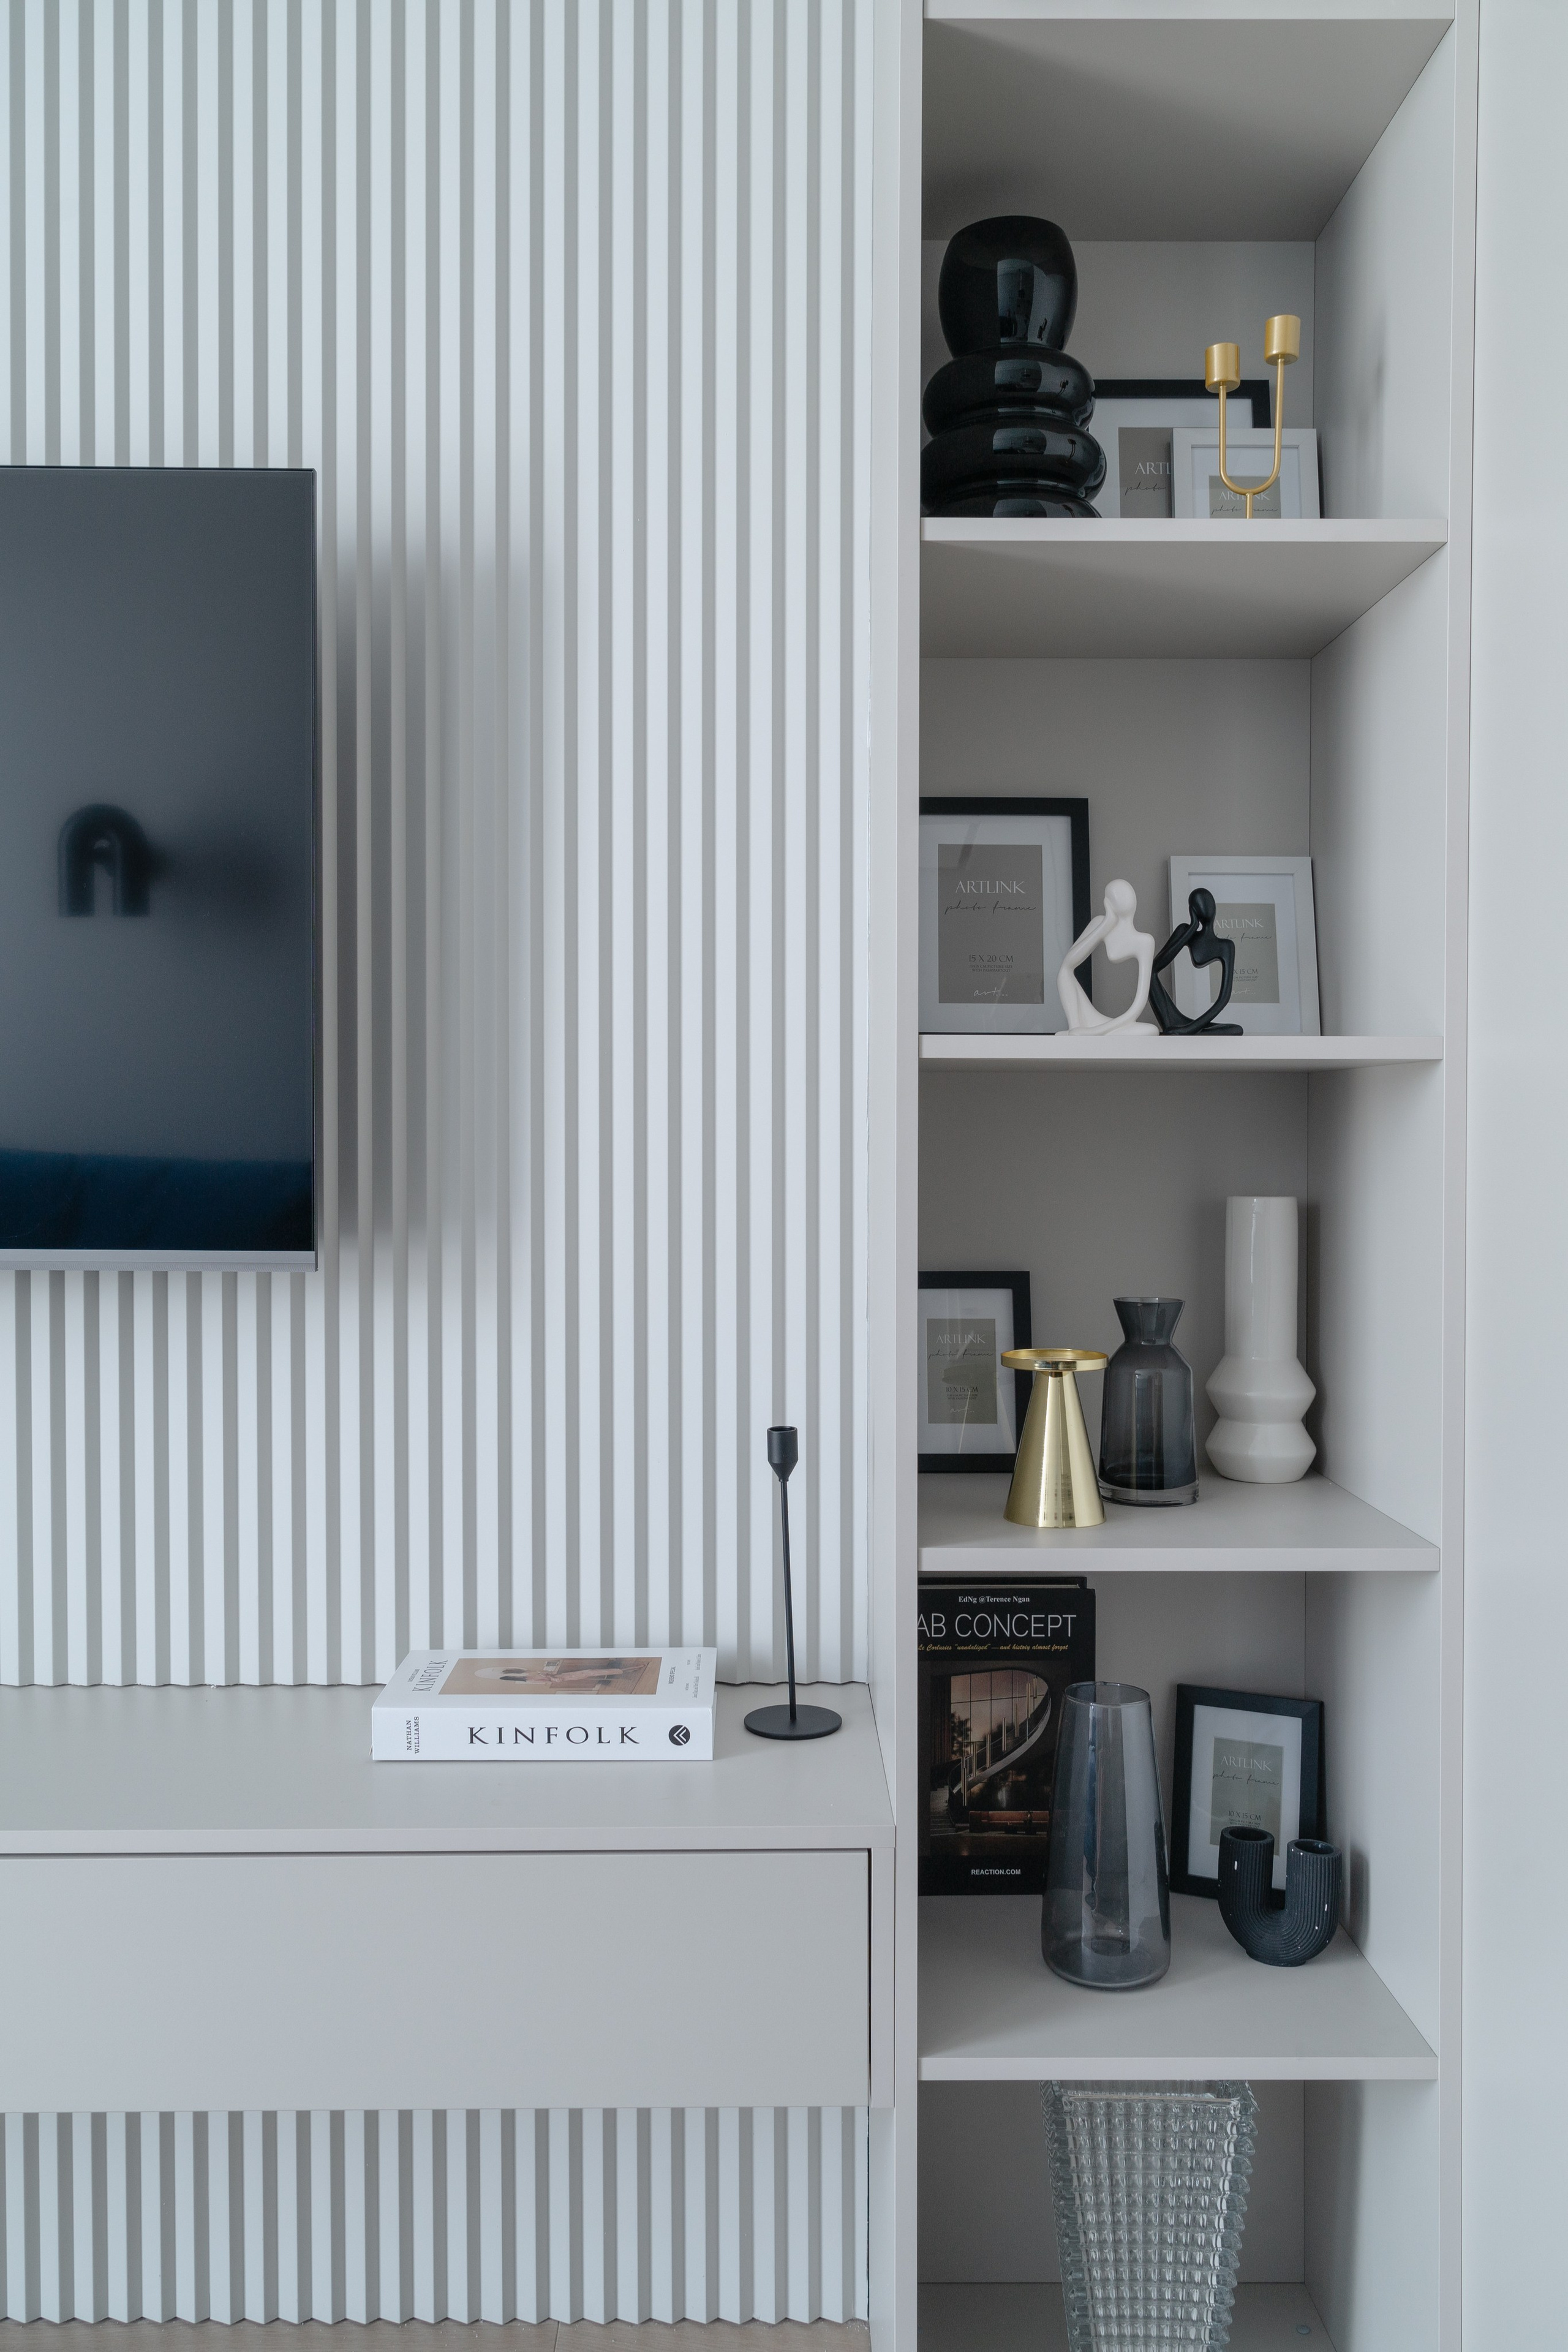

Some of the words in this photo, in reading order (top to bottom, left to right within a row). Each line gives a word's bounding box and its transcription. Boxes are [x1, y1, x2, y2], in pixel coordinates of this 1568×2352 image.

[955, 880, 1026, 894] ARTLINK
[944, 900, 986, 914] photo
[992, 900, 1036, 914] frame
[1214, 918, 1264, 929] ARTLINK
[1241, 932, 1272, 942] frame
[936, 1334, 986, 1344] ARTLINK
[928, 1349, 957, 1360] photo
[962, 1349, 993, 1359] frame
[918, 1613, 946, 1637] AB
[955, 1613, 1077, 1637] CONCEPT
[412, 1660, 448, 1691] KINFOLK
[467, 1726, 640, 1744] KINFOLK
[1221, 1755, 1272, 1771] ARTLINK
